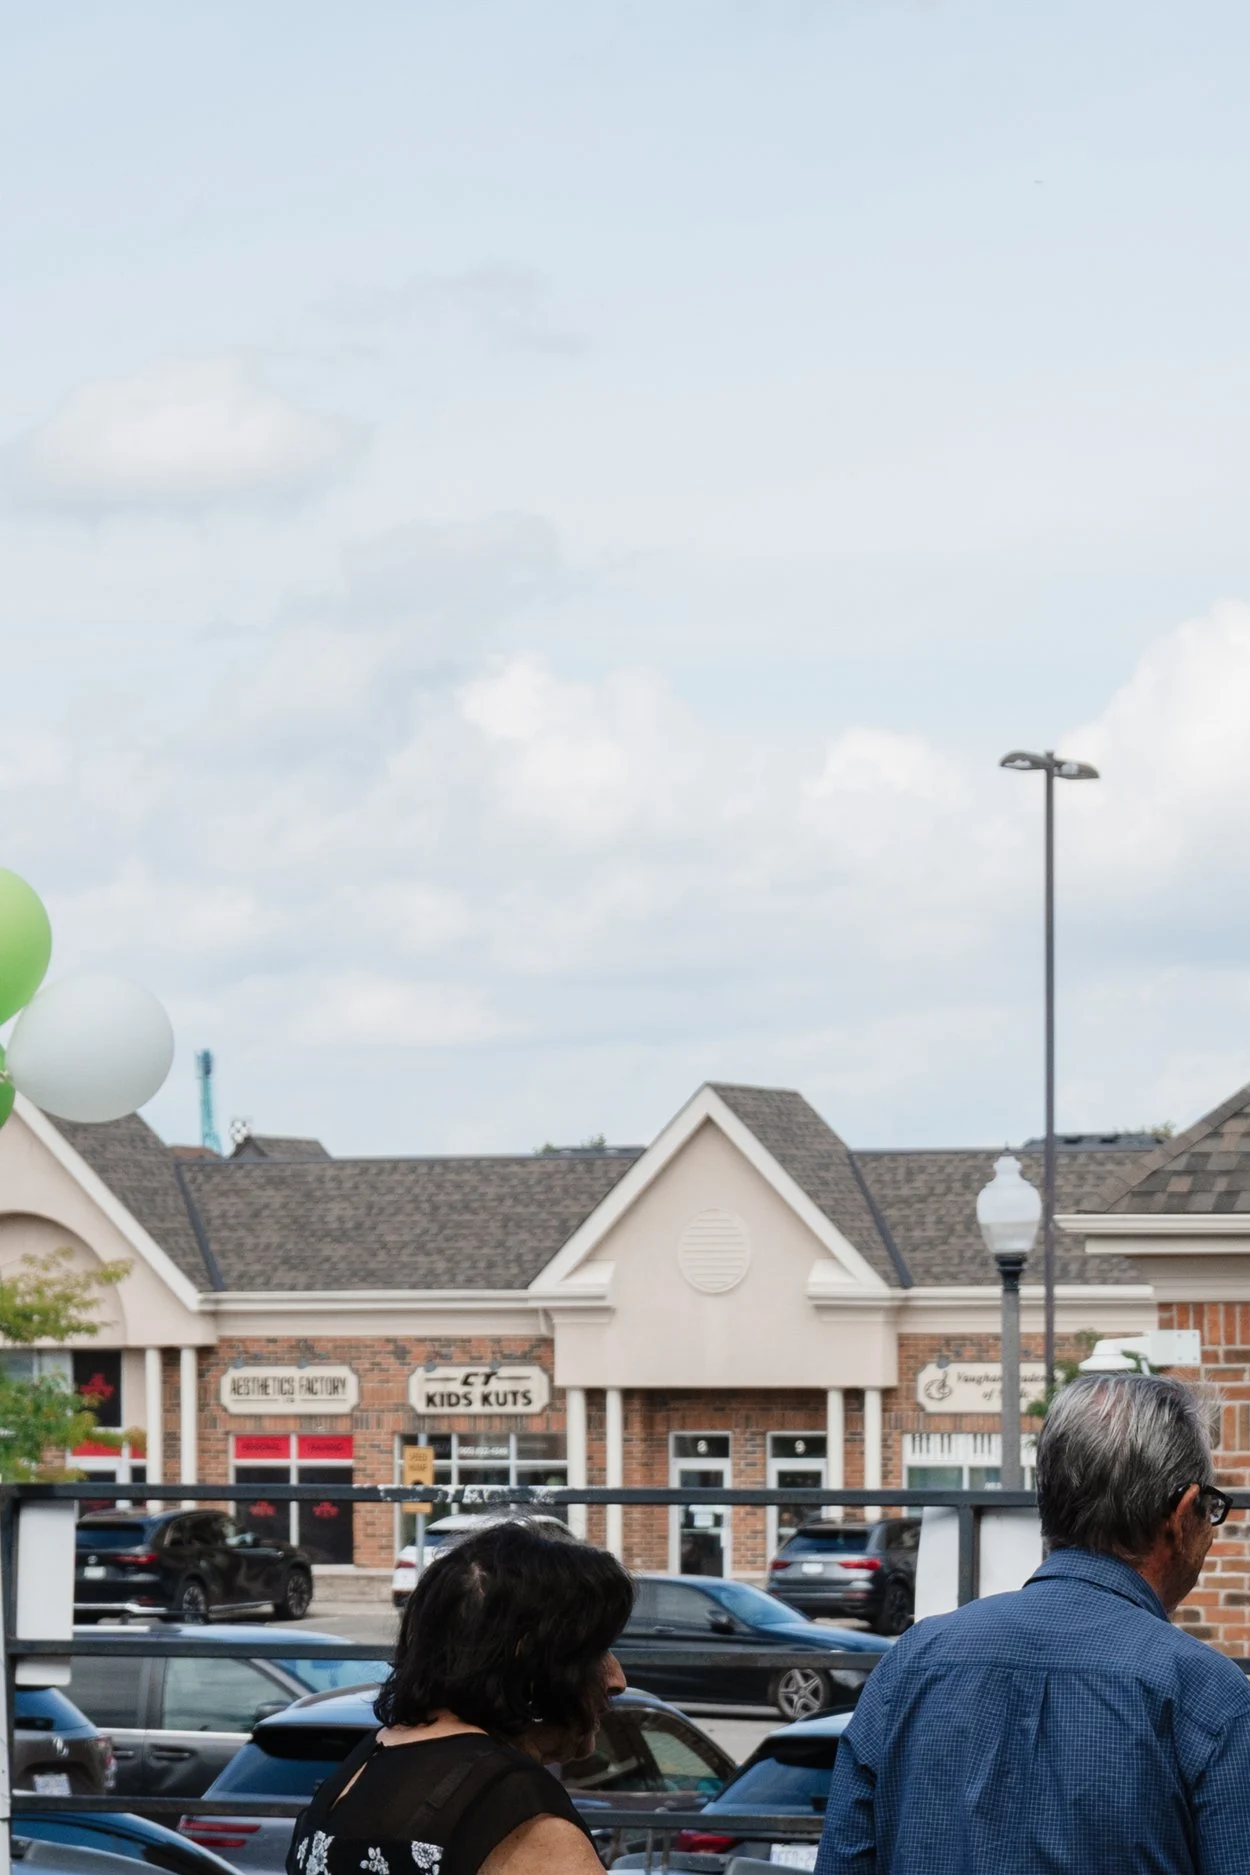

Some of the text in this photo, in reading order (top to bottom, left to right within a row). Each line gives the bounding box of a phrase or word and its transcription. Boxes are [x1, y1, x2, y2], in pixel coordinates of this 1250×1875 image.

[230, 1376, 347, 1396] AESTHETICS FACTORY
[425, 1390, 533, 1408] KIDS KUTS
